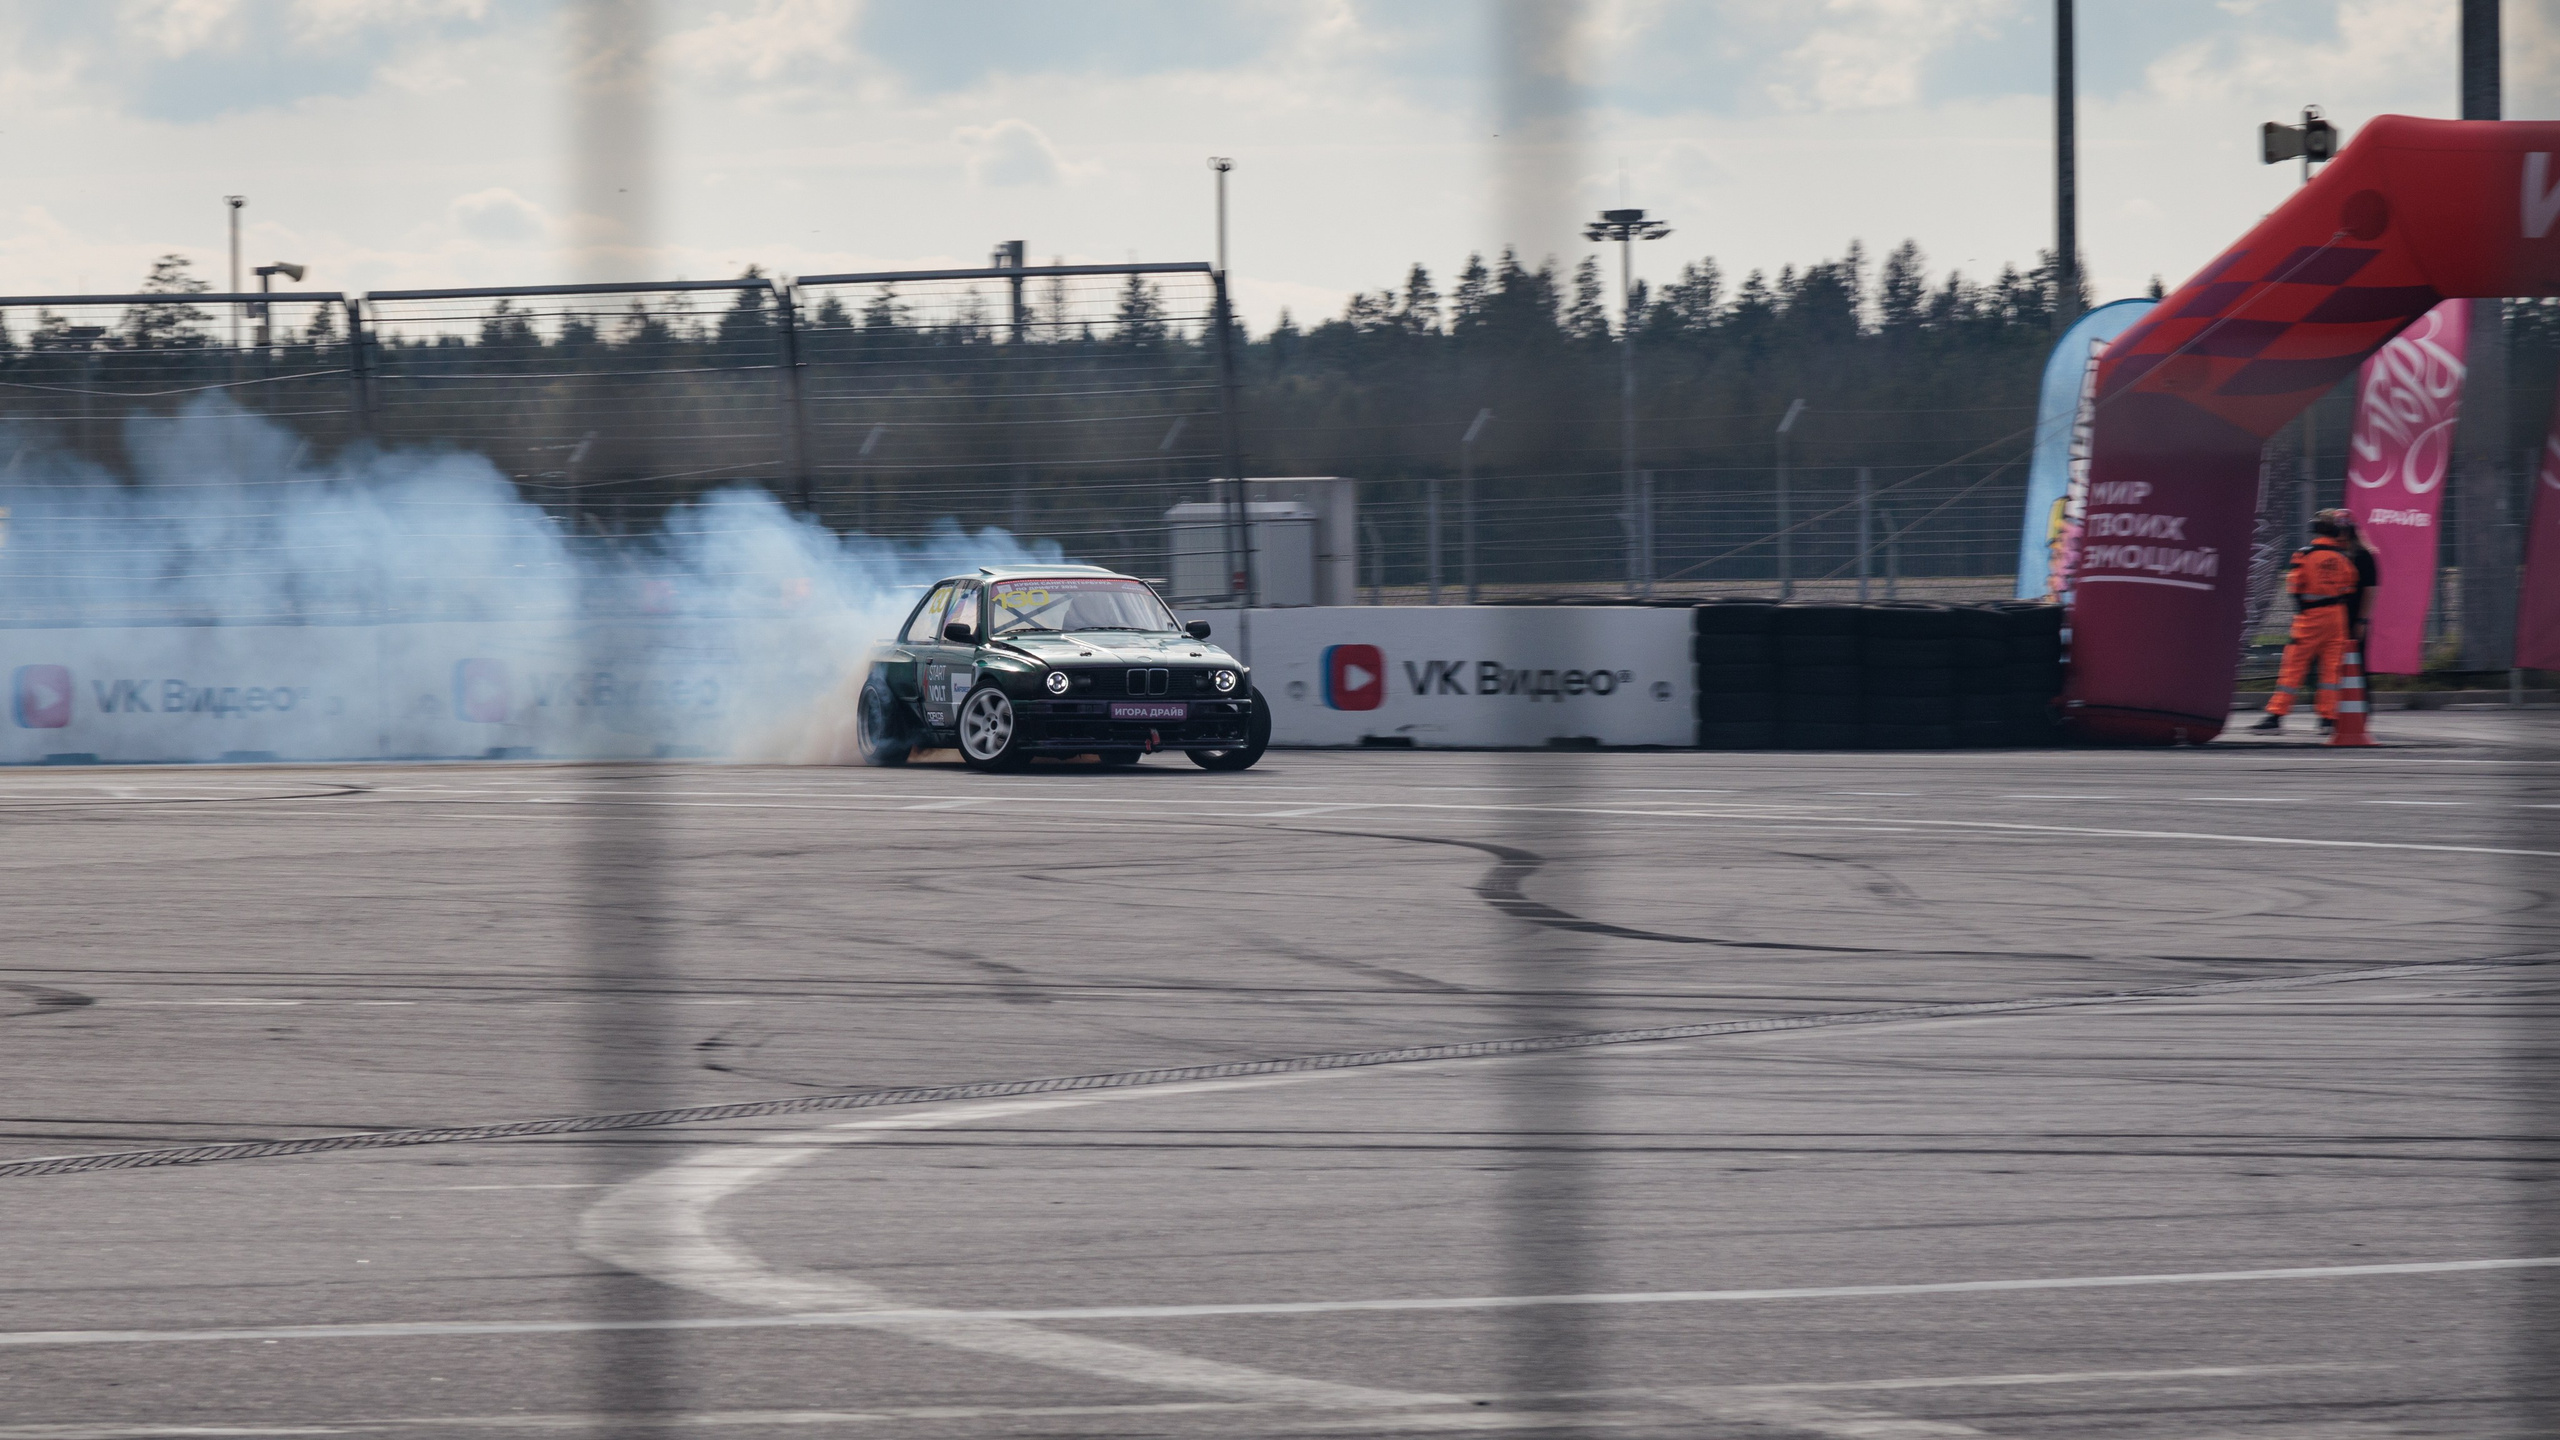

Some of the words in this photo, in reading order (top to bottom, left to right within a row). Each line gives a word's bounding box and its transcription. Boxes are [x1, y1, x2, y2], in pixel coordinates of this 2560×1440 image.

[2088, 480, 2153, 506] МИР
[2087, 512, 2188, 540] ТВОИХ
[2082, 545, 2219, 577] ЭМОЦИЙ
[992, 589, 1050, 610] 130
[929, 664, 947, 681] START
[1402, 660, 1468, 696] VK
[92, 678, 153, 713] VK
[929, 685, 946, 701] VOLT
[1114, 708, 1148, 716] ИГОРА
[1149, 706, 1184, 717] ДРАЙВ
